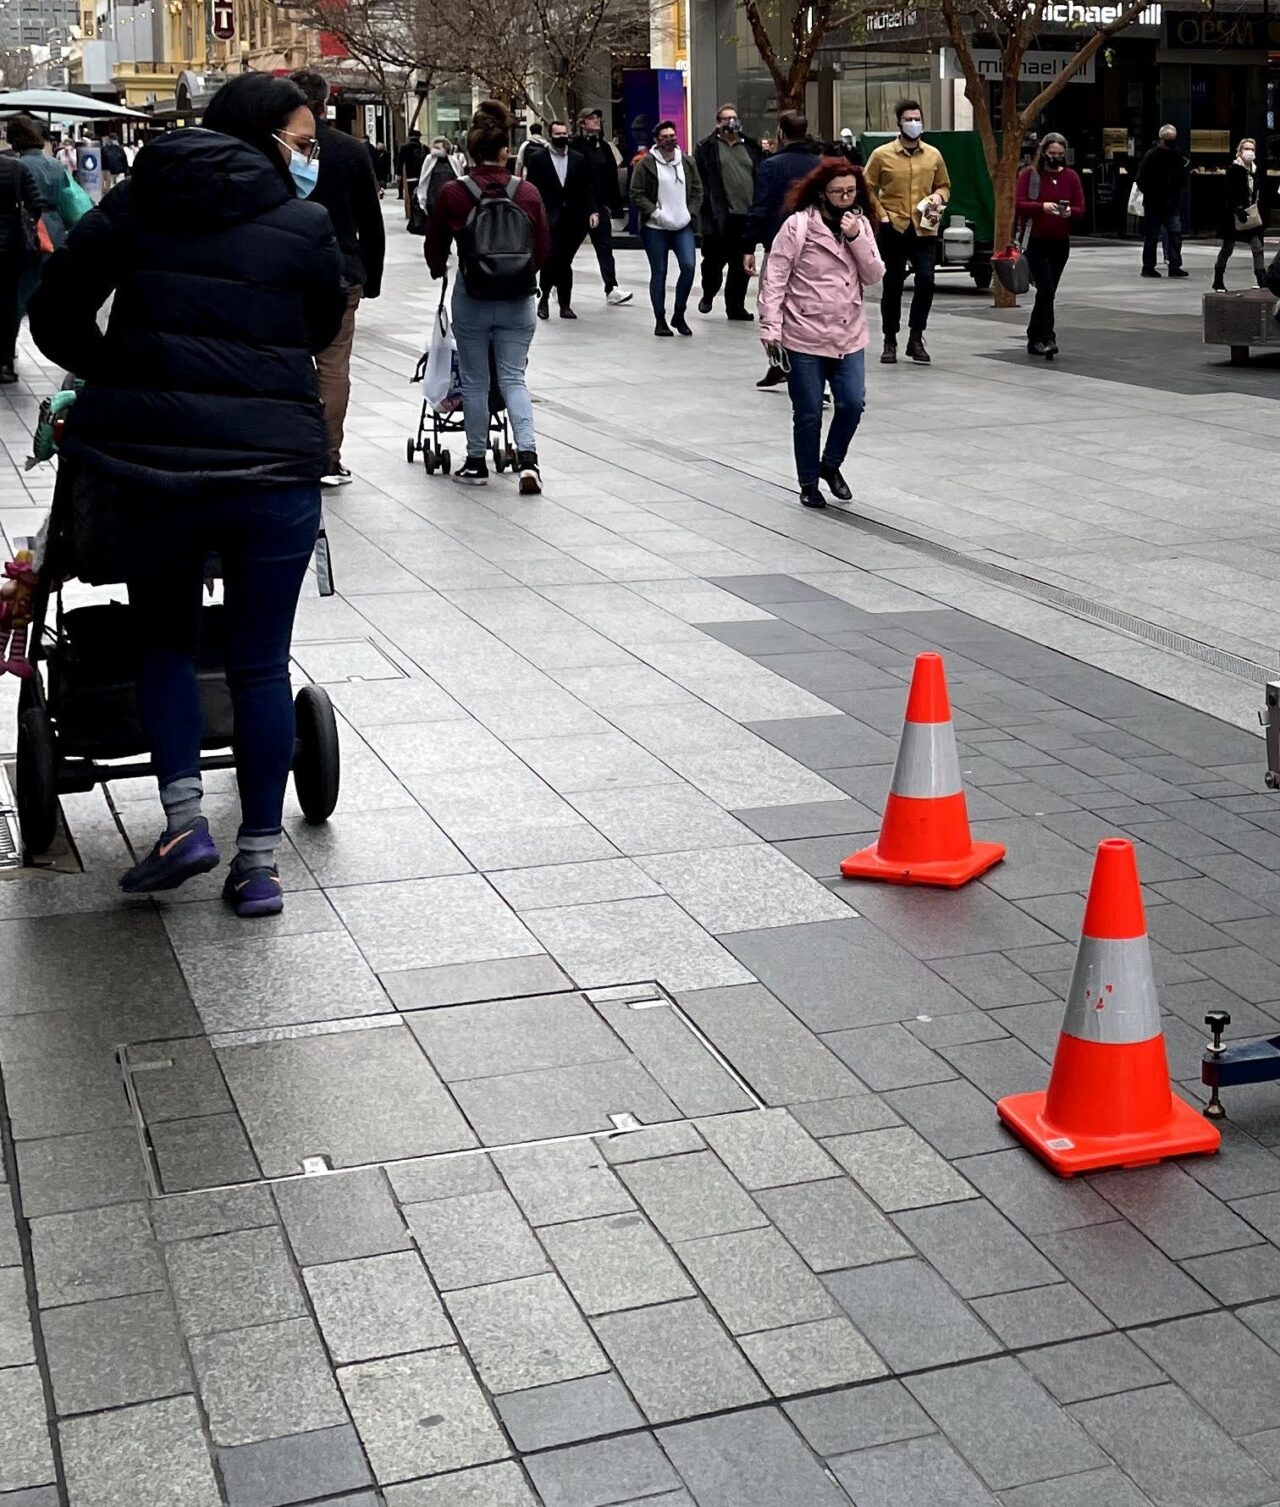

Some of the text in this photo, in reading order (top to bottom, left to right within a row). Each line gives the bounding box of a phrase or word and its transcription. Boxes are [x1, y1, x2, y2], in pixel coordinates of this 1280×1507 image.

[867, 8, 903, 31] michael
[1022, 0, 1122, 24] michael
[1177, 18, 1256, 45] OPSM
[978, 58, 1057, 75] miael
